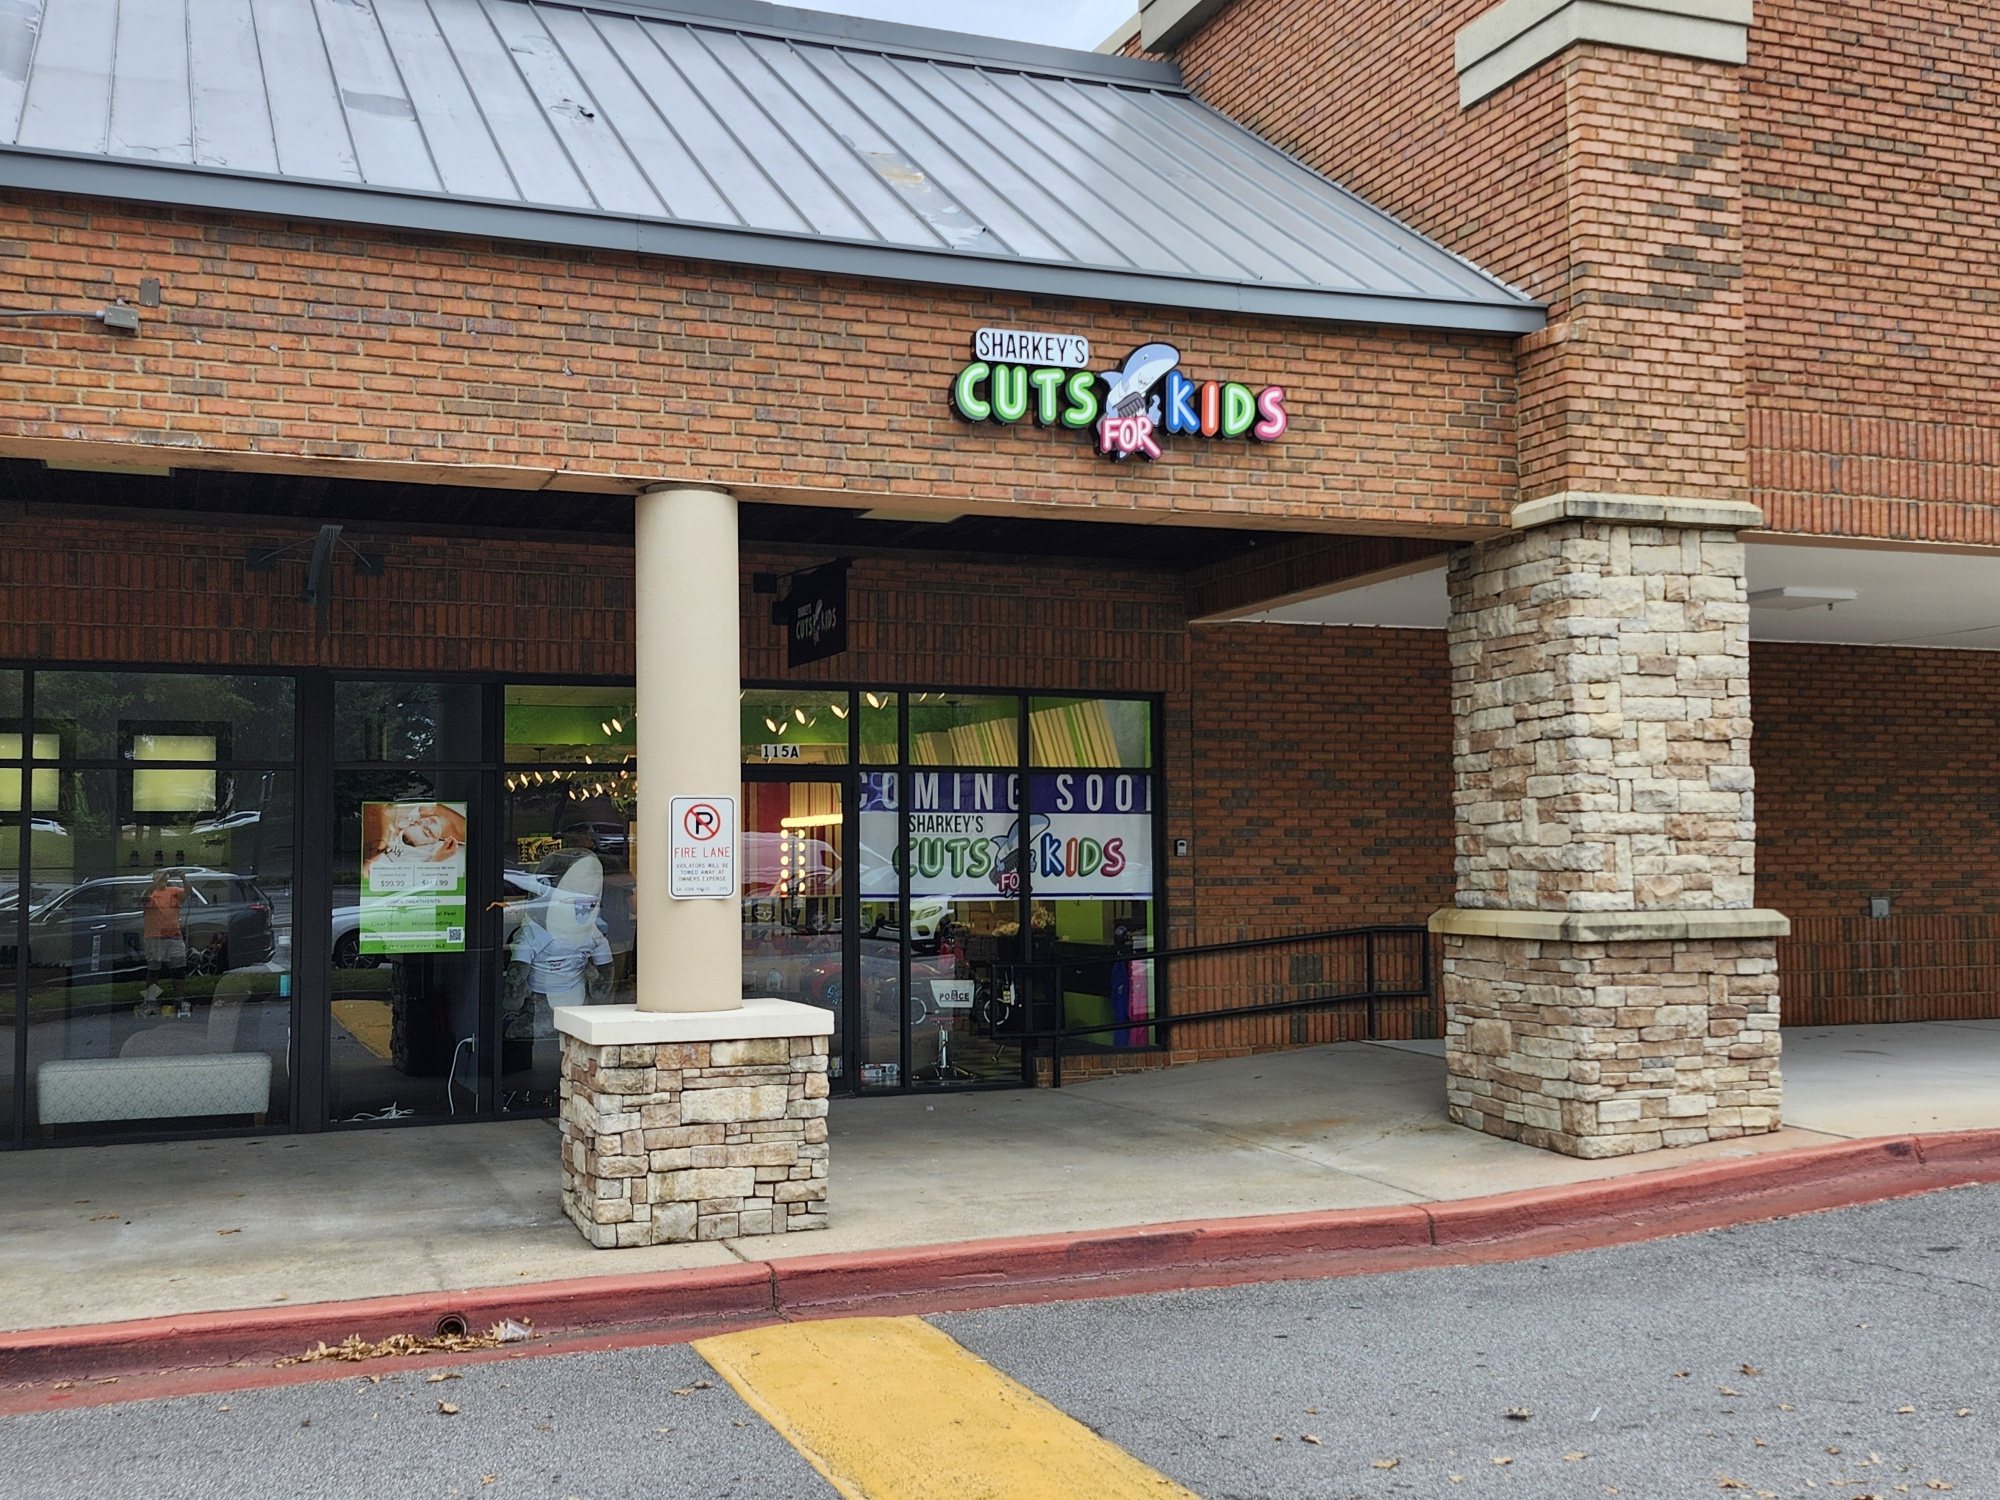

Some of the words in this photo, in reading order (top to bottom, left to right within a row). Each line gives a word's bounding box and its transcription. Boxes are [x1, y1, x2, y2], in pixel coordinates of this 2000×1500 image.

[979, 332, 1086, 364] SHARKEY'S
[955, 363, 1097, 428] CUTS
[1101, 416, 1161, 459] FOR
[1166, 370, 1288, 441] KIDS
[764, 745, 799, 758] 115A
[909, 814, 984, 833] SHARKEY'S
[674, 847, 697, 858] FIRE
[703, 846, 731, 858] LANE
[998, 873, 1020, 893] FO
[1040, 832, 1126, 877] KIDS
[940, 992, 970, 1001] POLICE
